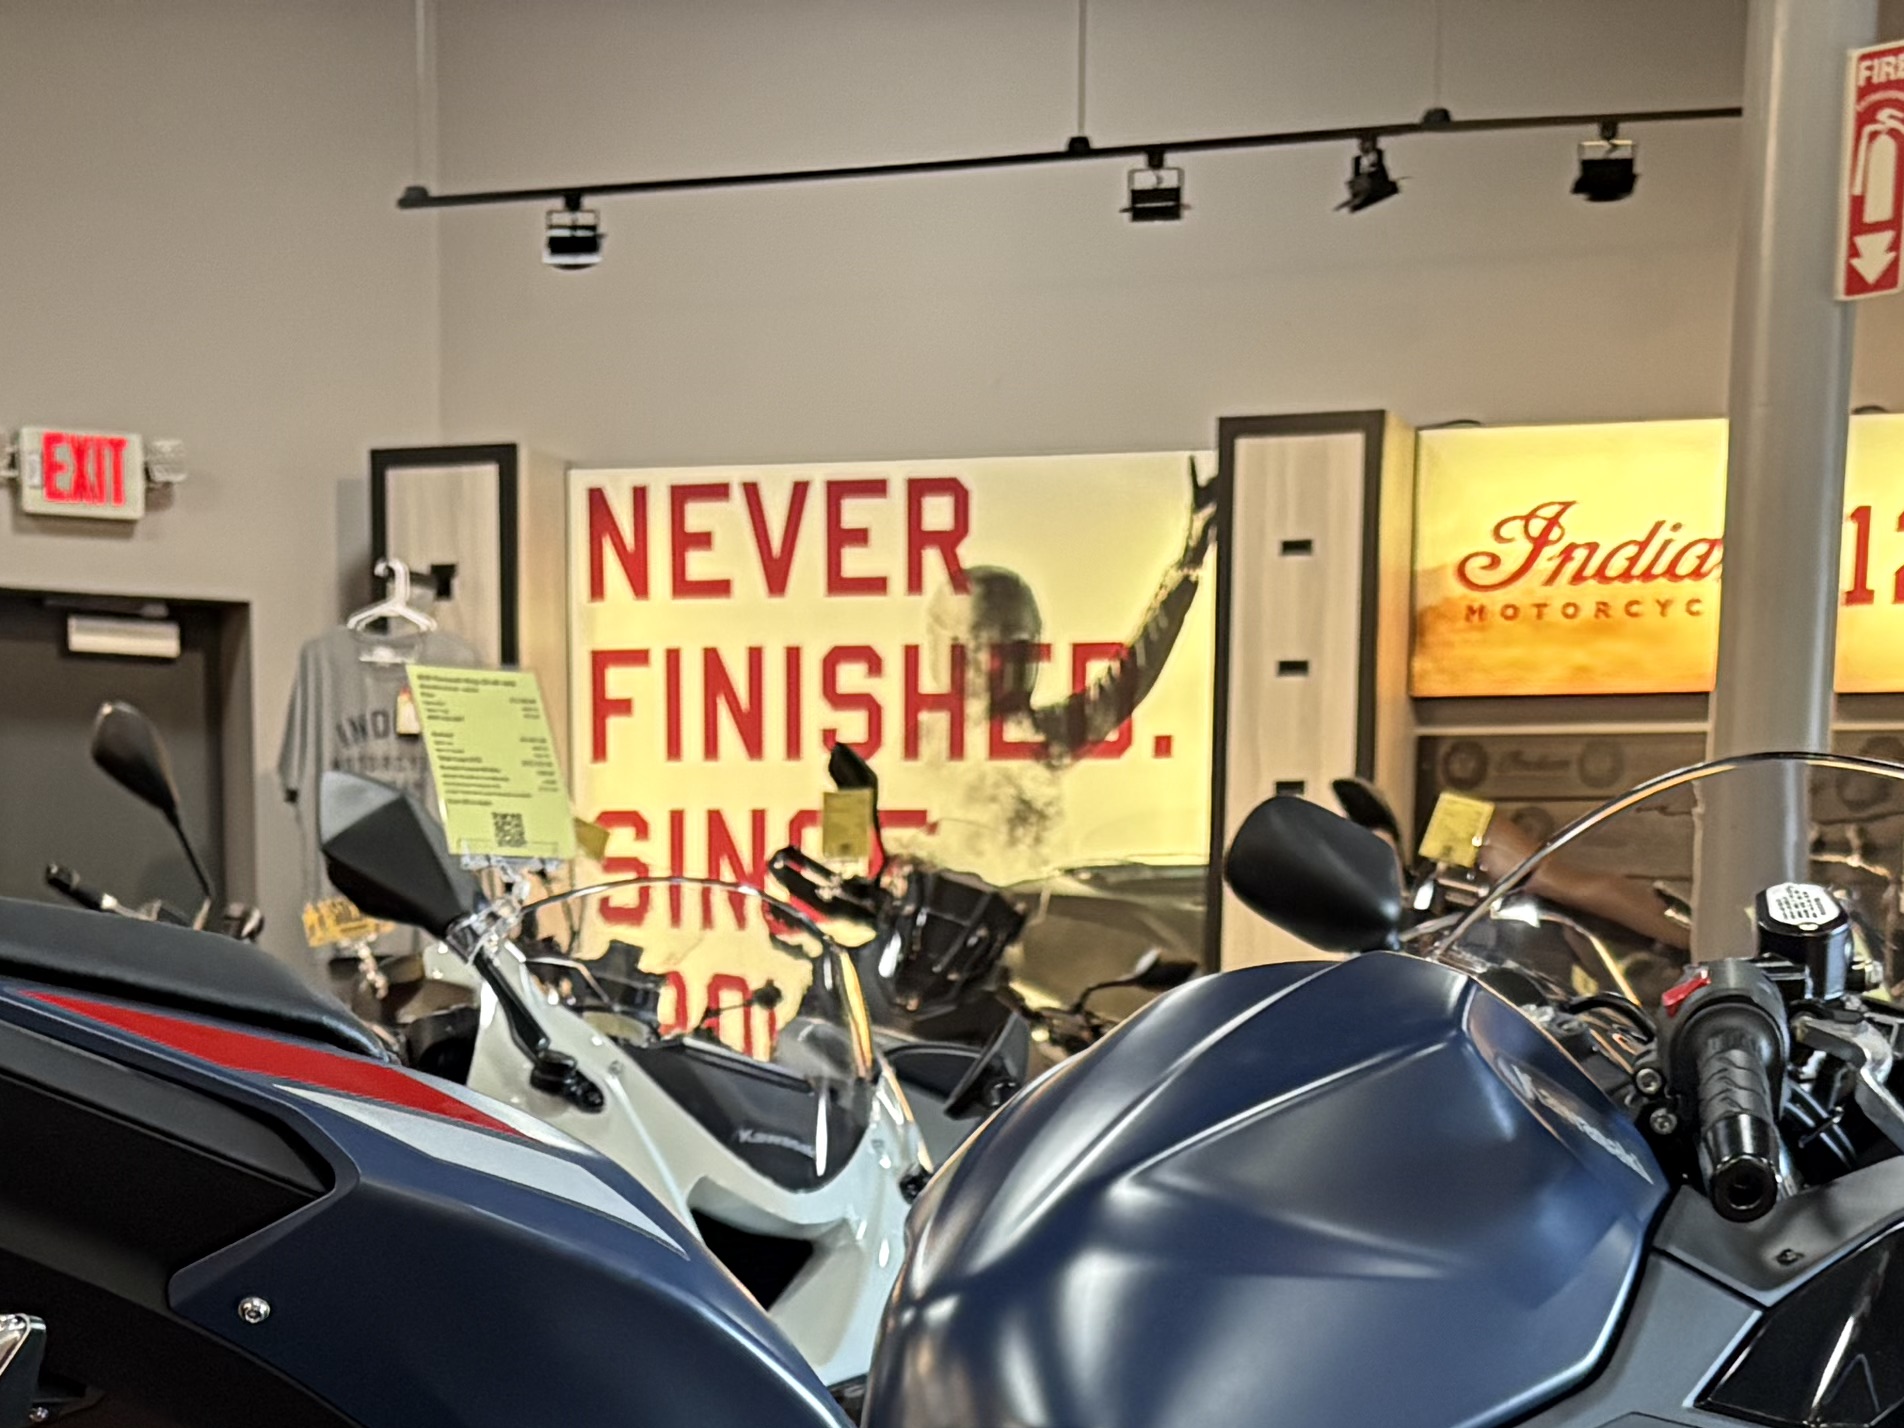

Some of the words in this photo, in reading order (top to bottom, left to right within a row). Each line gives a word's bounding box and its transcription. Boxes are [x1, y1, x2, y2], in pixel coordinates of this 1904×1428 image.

[41, 431, 127, 506] EXIT
[587, 476, 972, 604] NEVER
[1455, 500, 1725, 596] India
[588, 642, 1174, 765] FINISHED.
